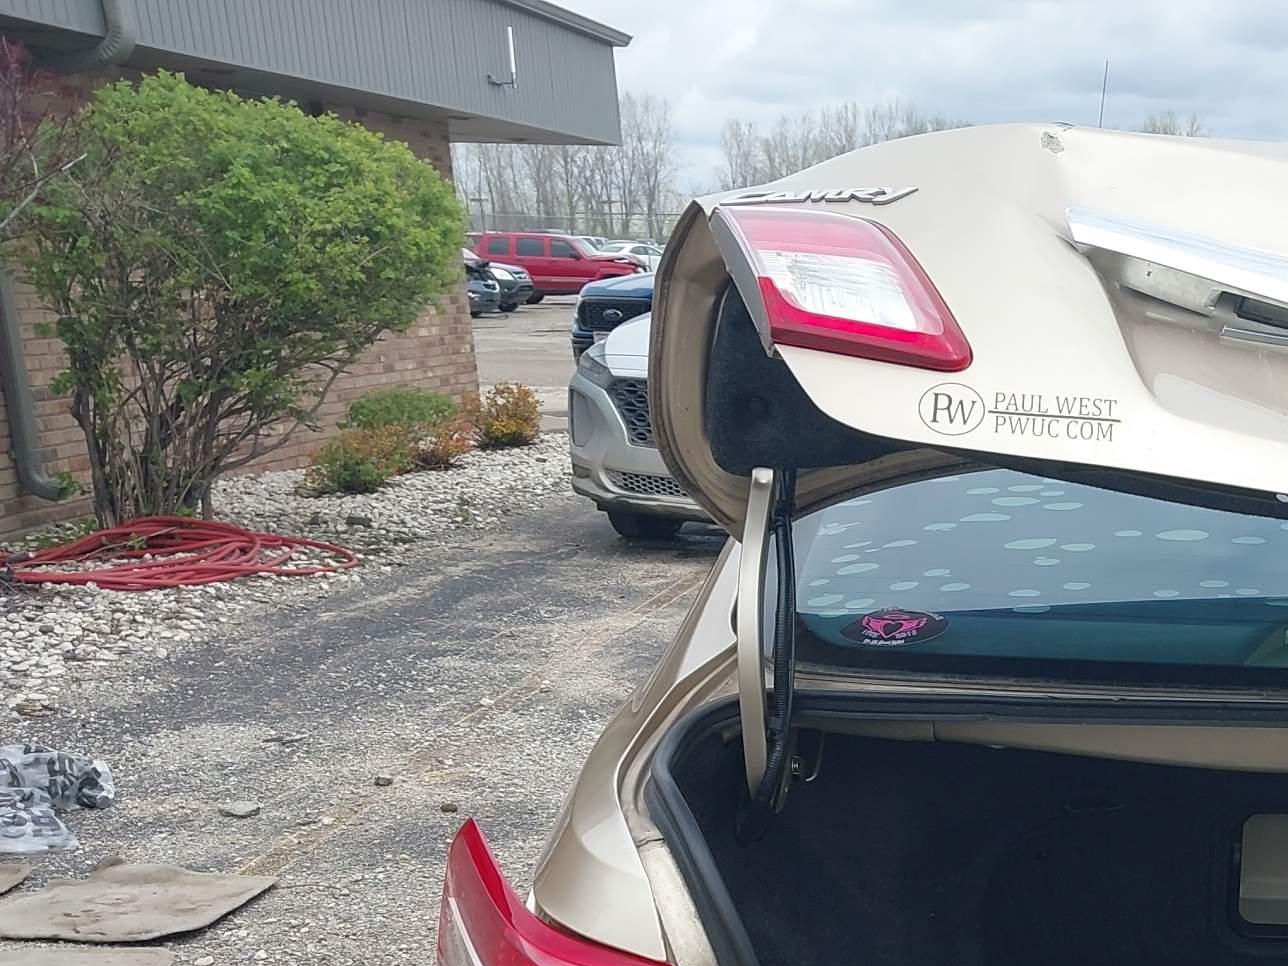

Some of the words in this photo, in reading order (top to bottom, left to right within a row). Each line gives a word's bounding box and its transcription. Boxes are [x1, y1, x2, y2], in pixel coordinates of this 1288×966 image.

[719, 187, 919, 206] CAMRY
[930, 392, 977, 426] PW
[993, 392, 1049, 414] PAUL
[1055, 396, 1118, 418] WEST
